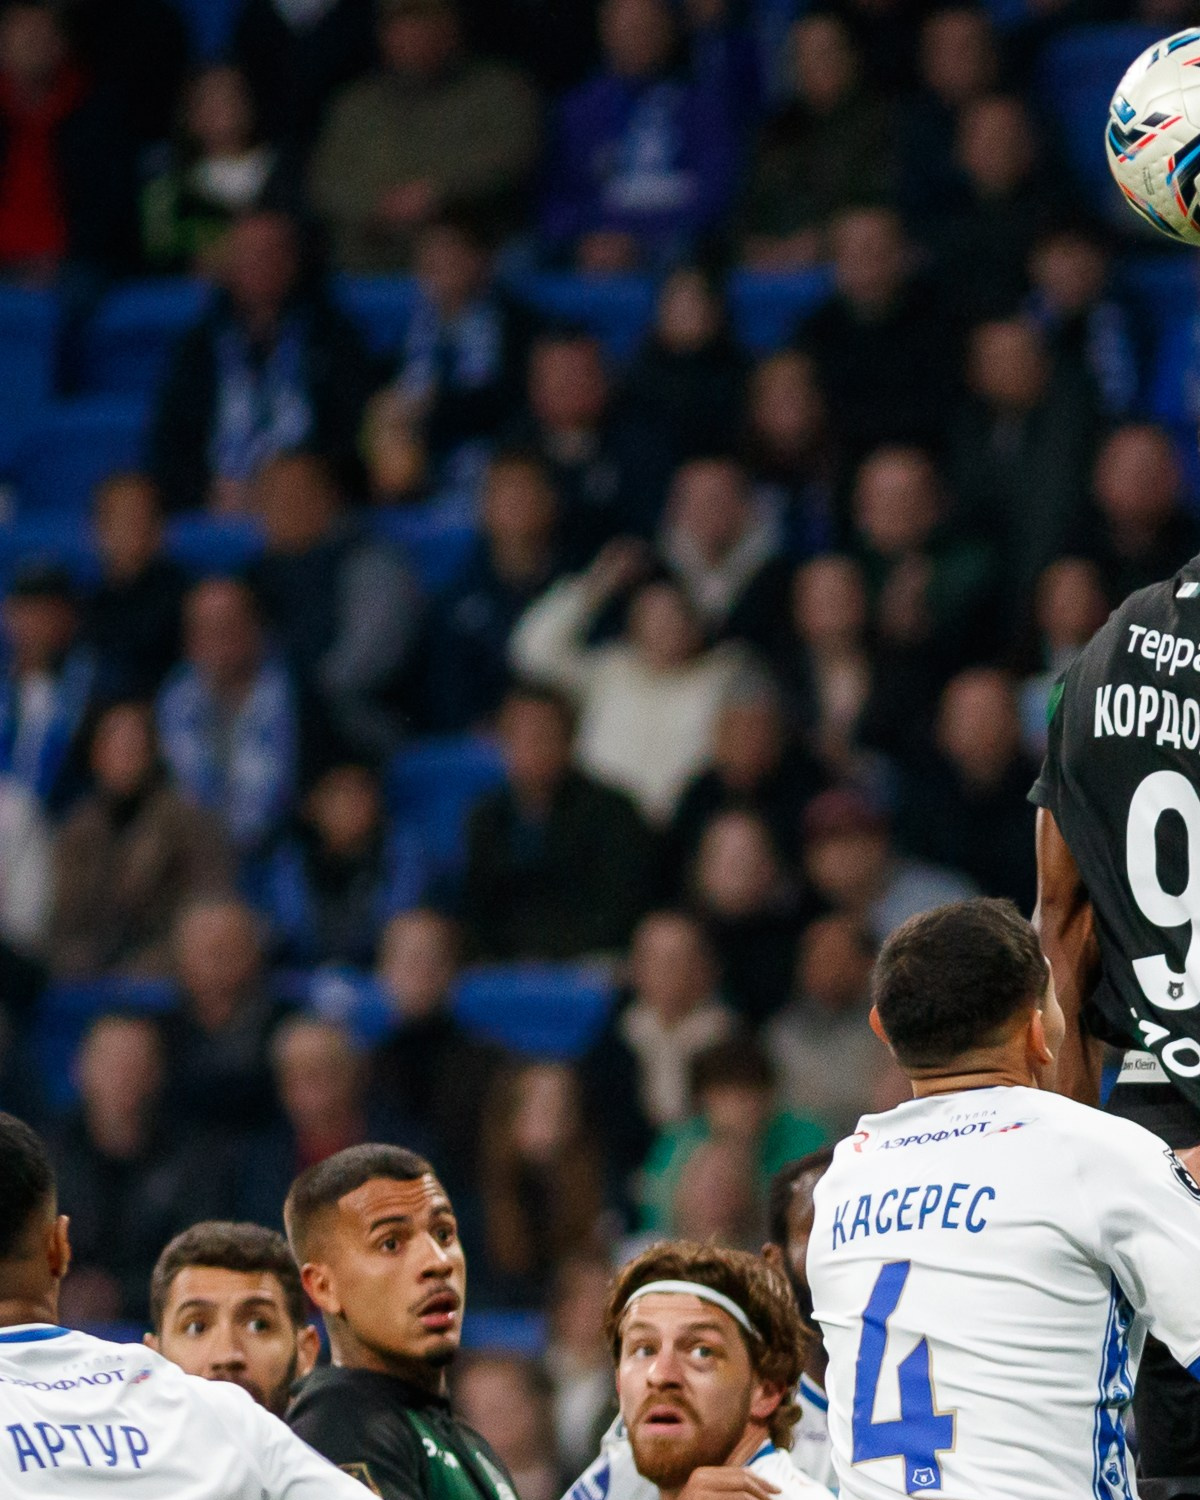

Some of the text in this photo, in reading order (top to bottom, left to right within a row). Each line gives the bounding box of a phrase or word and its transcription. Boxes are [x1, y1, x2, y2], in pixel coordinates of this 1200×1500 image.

[877, 1121, 992, 1151] АЭРОФЛОТ
[831, 1182, 996, 1251] КАСЕРЕС
[851, 1259, 958, 1496] 4
[5, 1420, 150, 1473] АРТУР
